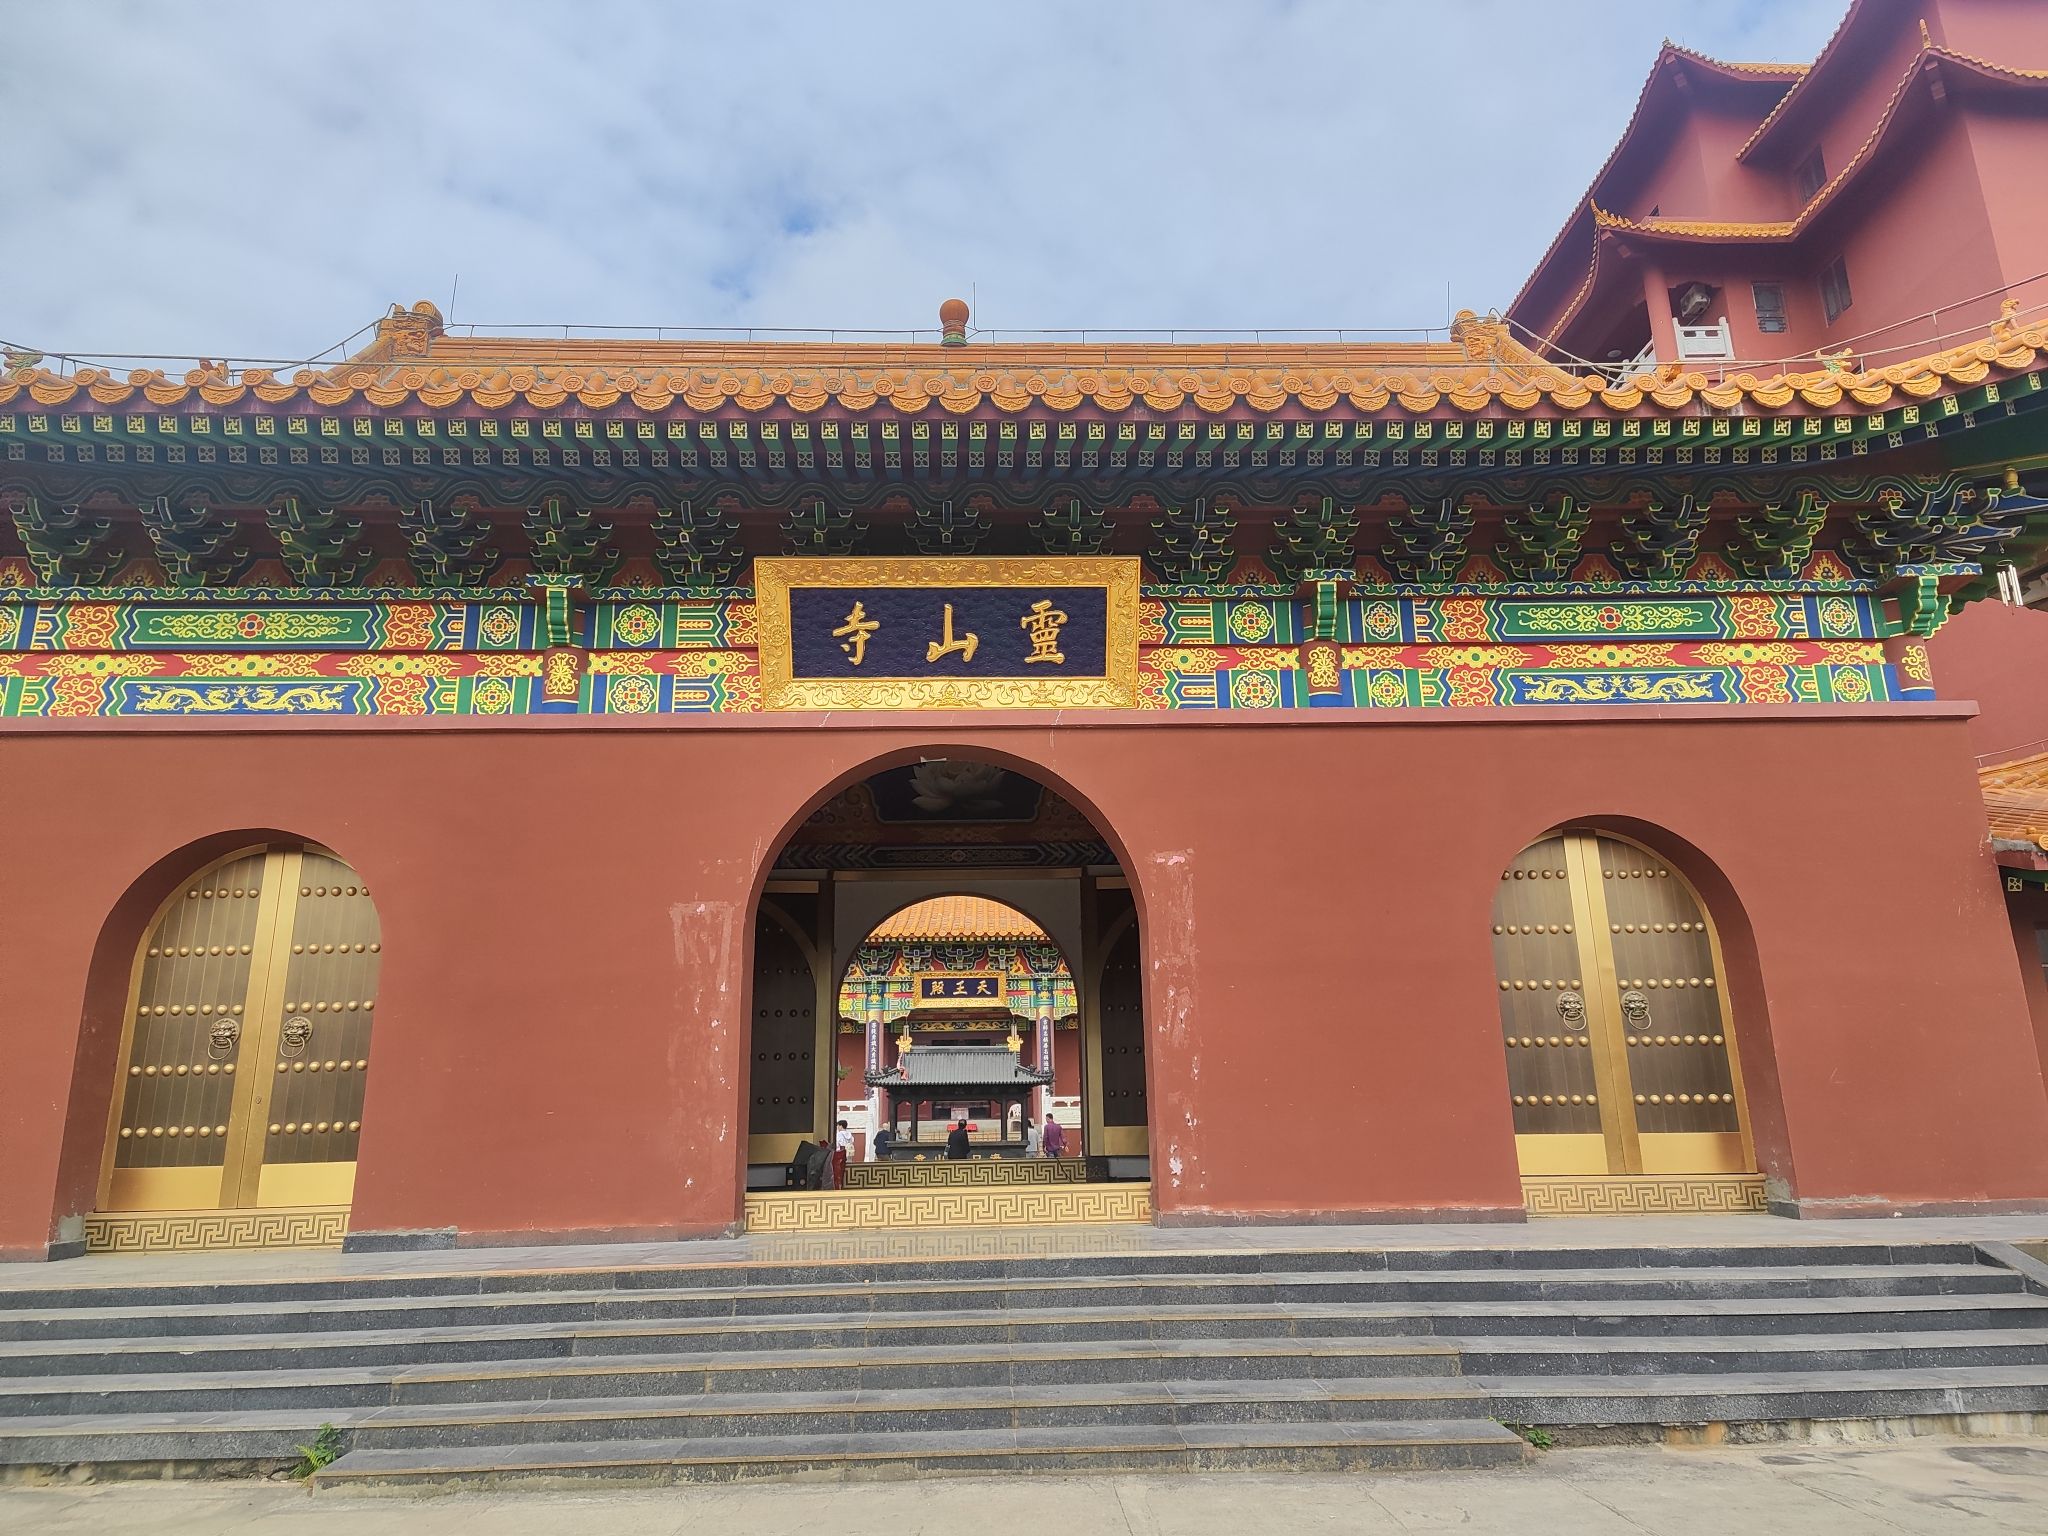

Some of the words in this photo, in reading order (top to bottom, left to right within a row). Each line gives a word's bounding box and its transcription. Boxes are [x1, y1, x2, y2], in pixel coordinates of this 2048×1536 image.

[832, 599, 1068, 666] 靈山寺
[929, 980, 992, 996] 天王殿
